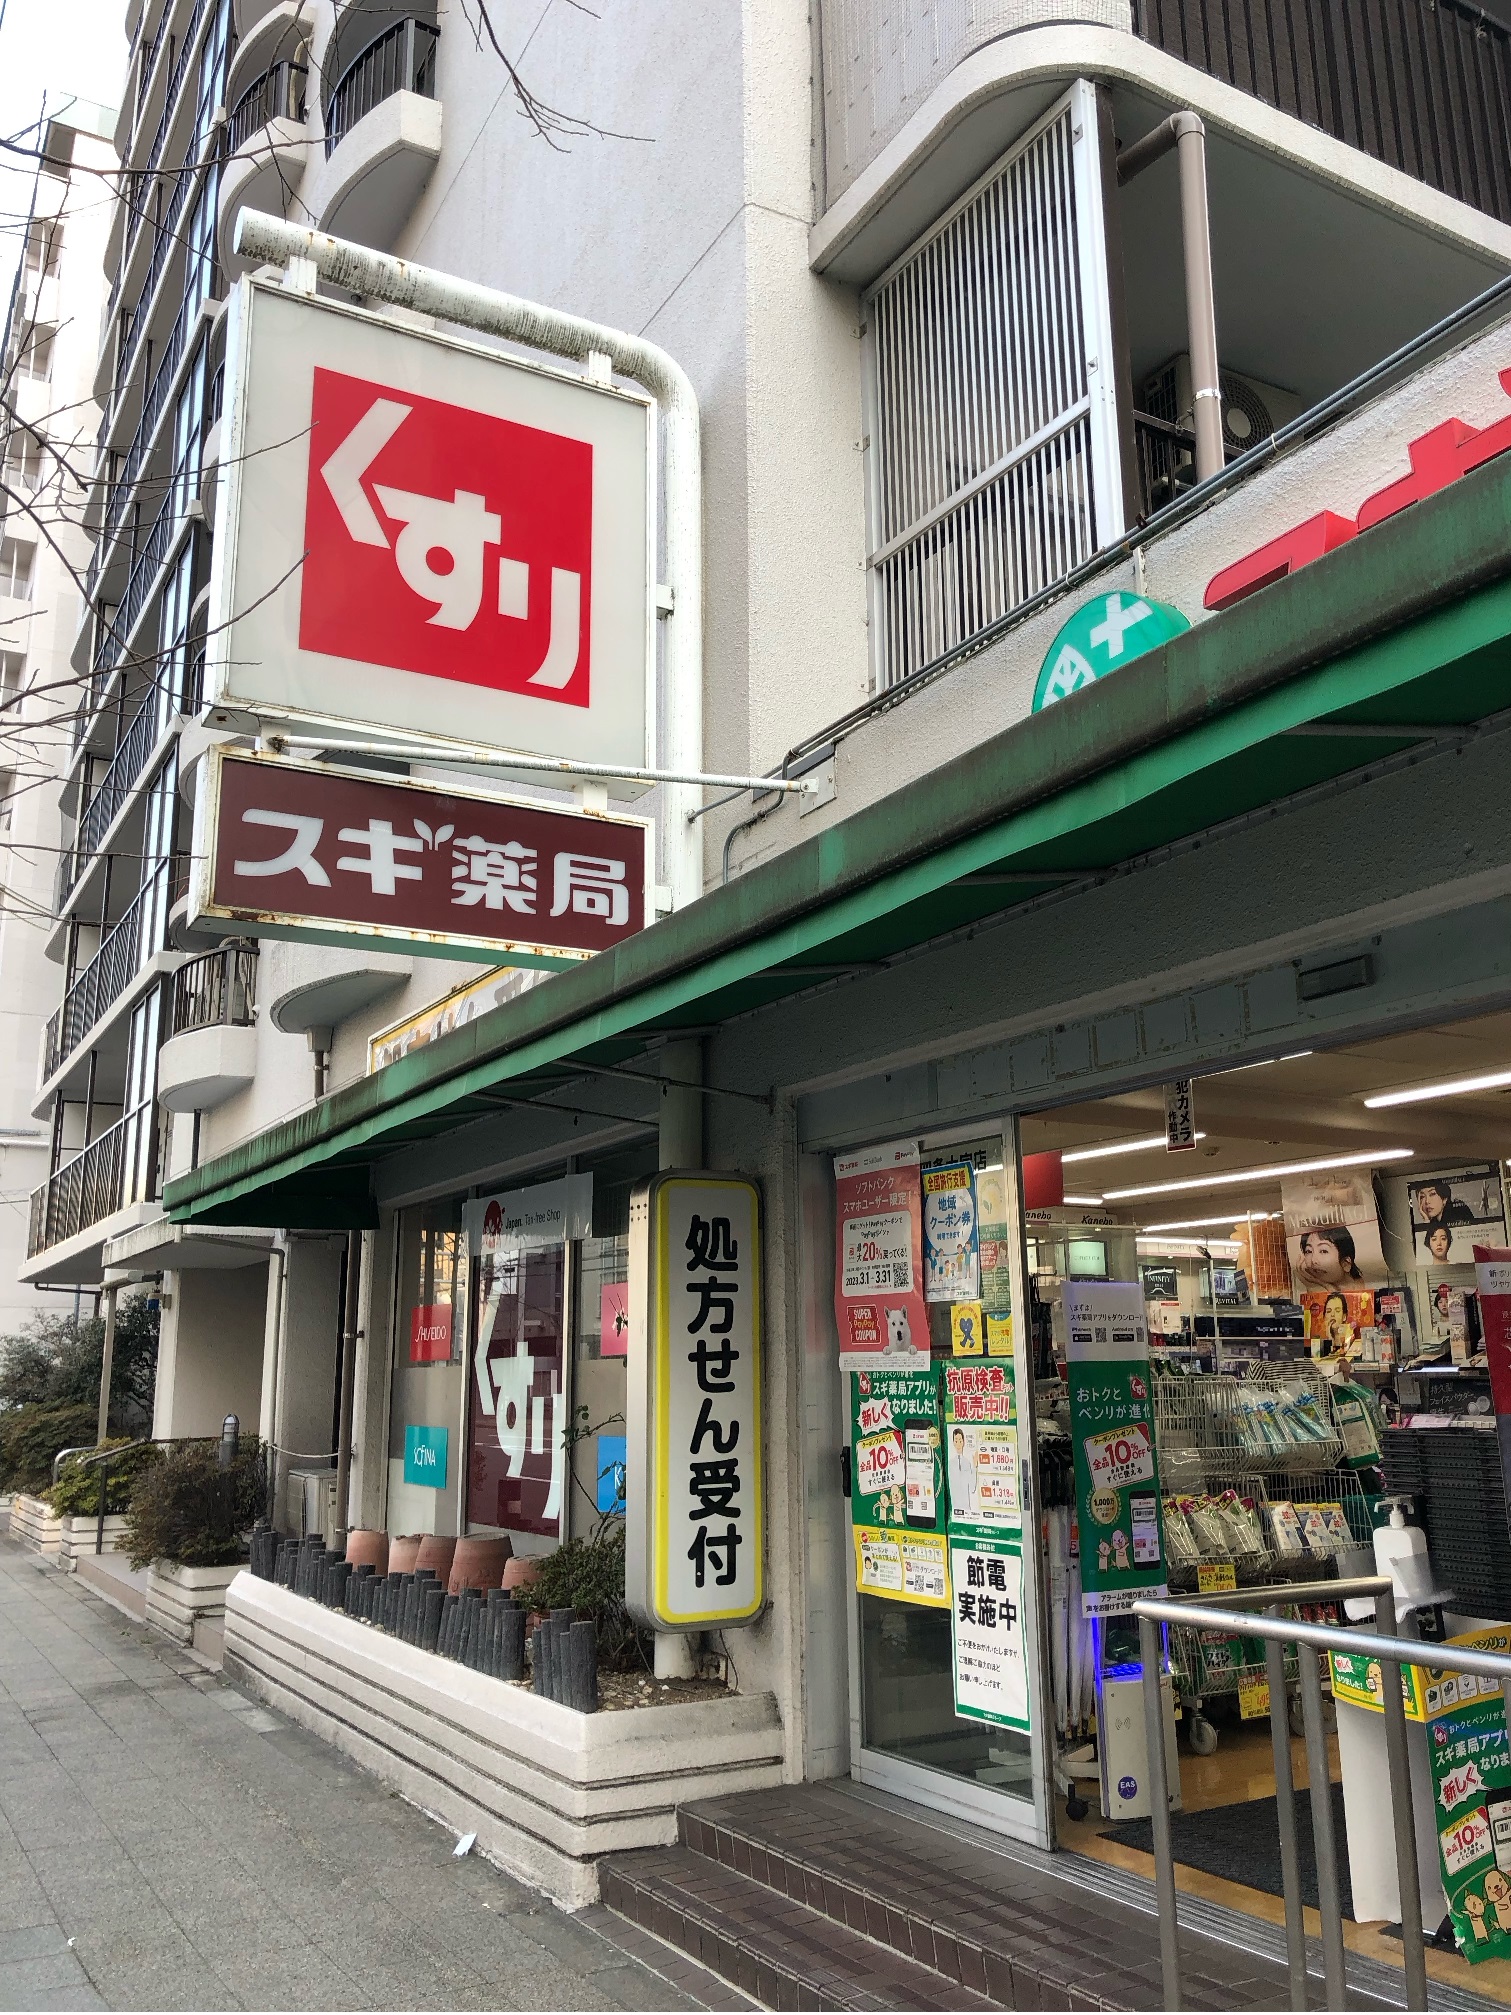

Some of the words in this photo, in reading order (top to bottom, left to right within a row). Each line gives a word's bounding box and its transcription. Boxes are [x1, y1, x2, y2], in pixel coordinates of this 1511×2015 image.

[320, 398, 581, 689] くすり
[234, 808, 630, 926] スギ薬局
[1168, 1111, 1178, 1144] 作動中
[855, 1176, 895, 1195] ソフトバンク
[928, 1169, 967, 1192] 全国旅行支援
[938, 1195, 957, 1212] 地域
[546, 1208, 561, 1223] Shop
[929, 1211, 971, 1230] クーポン券
[1081, 1214, 1114, 1226] Kanebo
[853, 1308, 872, 1320] SUPER
[415, 1325, 447, 1343] SHISEIDO
[855, 1329, 877, 1341] COUPON
[992, 1337, 1010, 1345] レンタル
[872, 1379, 937, 1396] スギ薬局アプリが
[1076, 1387, 1122, 1403] おトクと
[474, 1294, 566, 1520] くすり
[685, 1213, 743, 1588] 処方せん受付
[891, 1398, 937, 1416] なりました!
[953, 1394, 1011, 1421] 販売中!!
[861, 1402, 890, 1429] 新しく
[413, 1445, 436, 1467] SOFINA
[1106, 1466, 1143, 1484] すぐに使える
[966, 1554, 1007, 1592] 節電
[1101, 1590, 1158, 1602] アラームが鳴りましたら
[957, 1591, 1018, 1632] 実施中
[1120, 1780, 1136, 1789] EAS
[1443, 1766, 1478, 1804] 新しく
